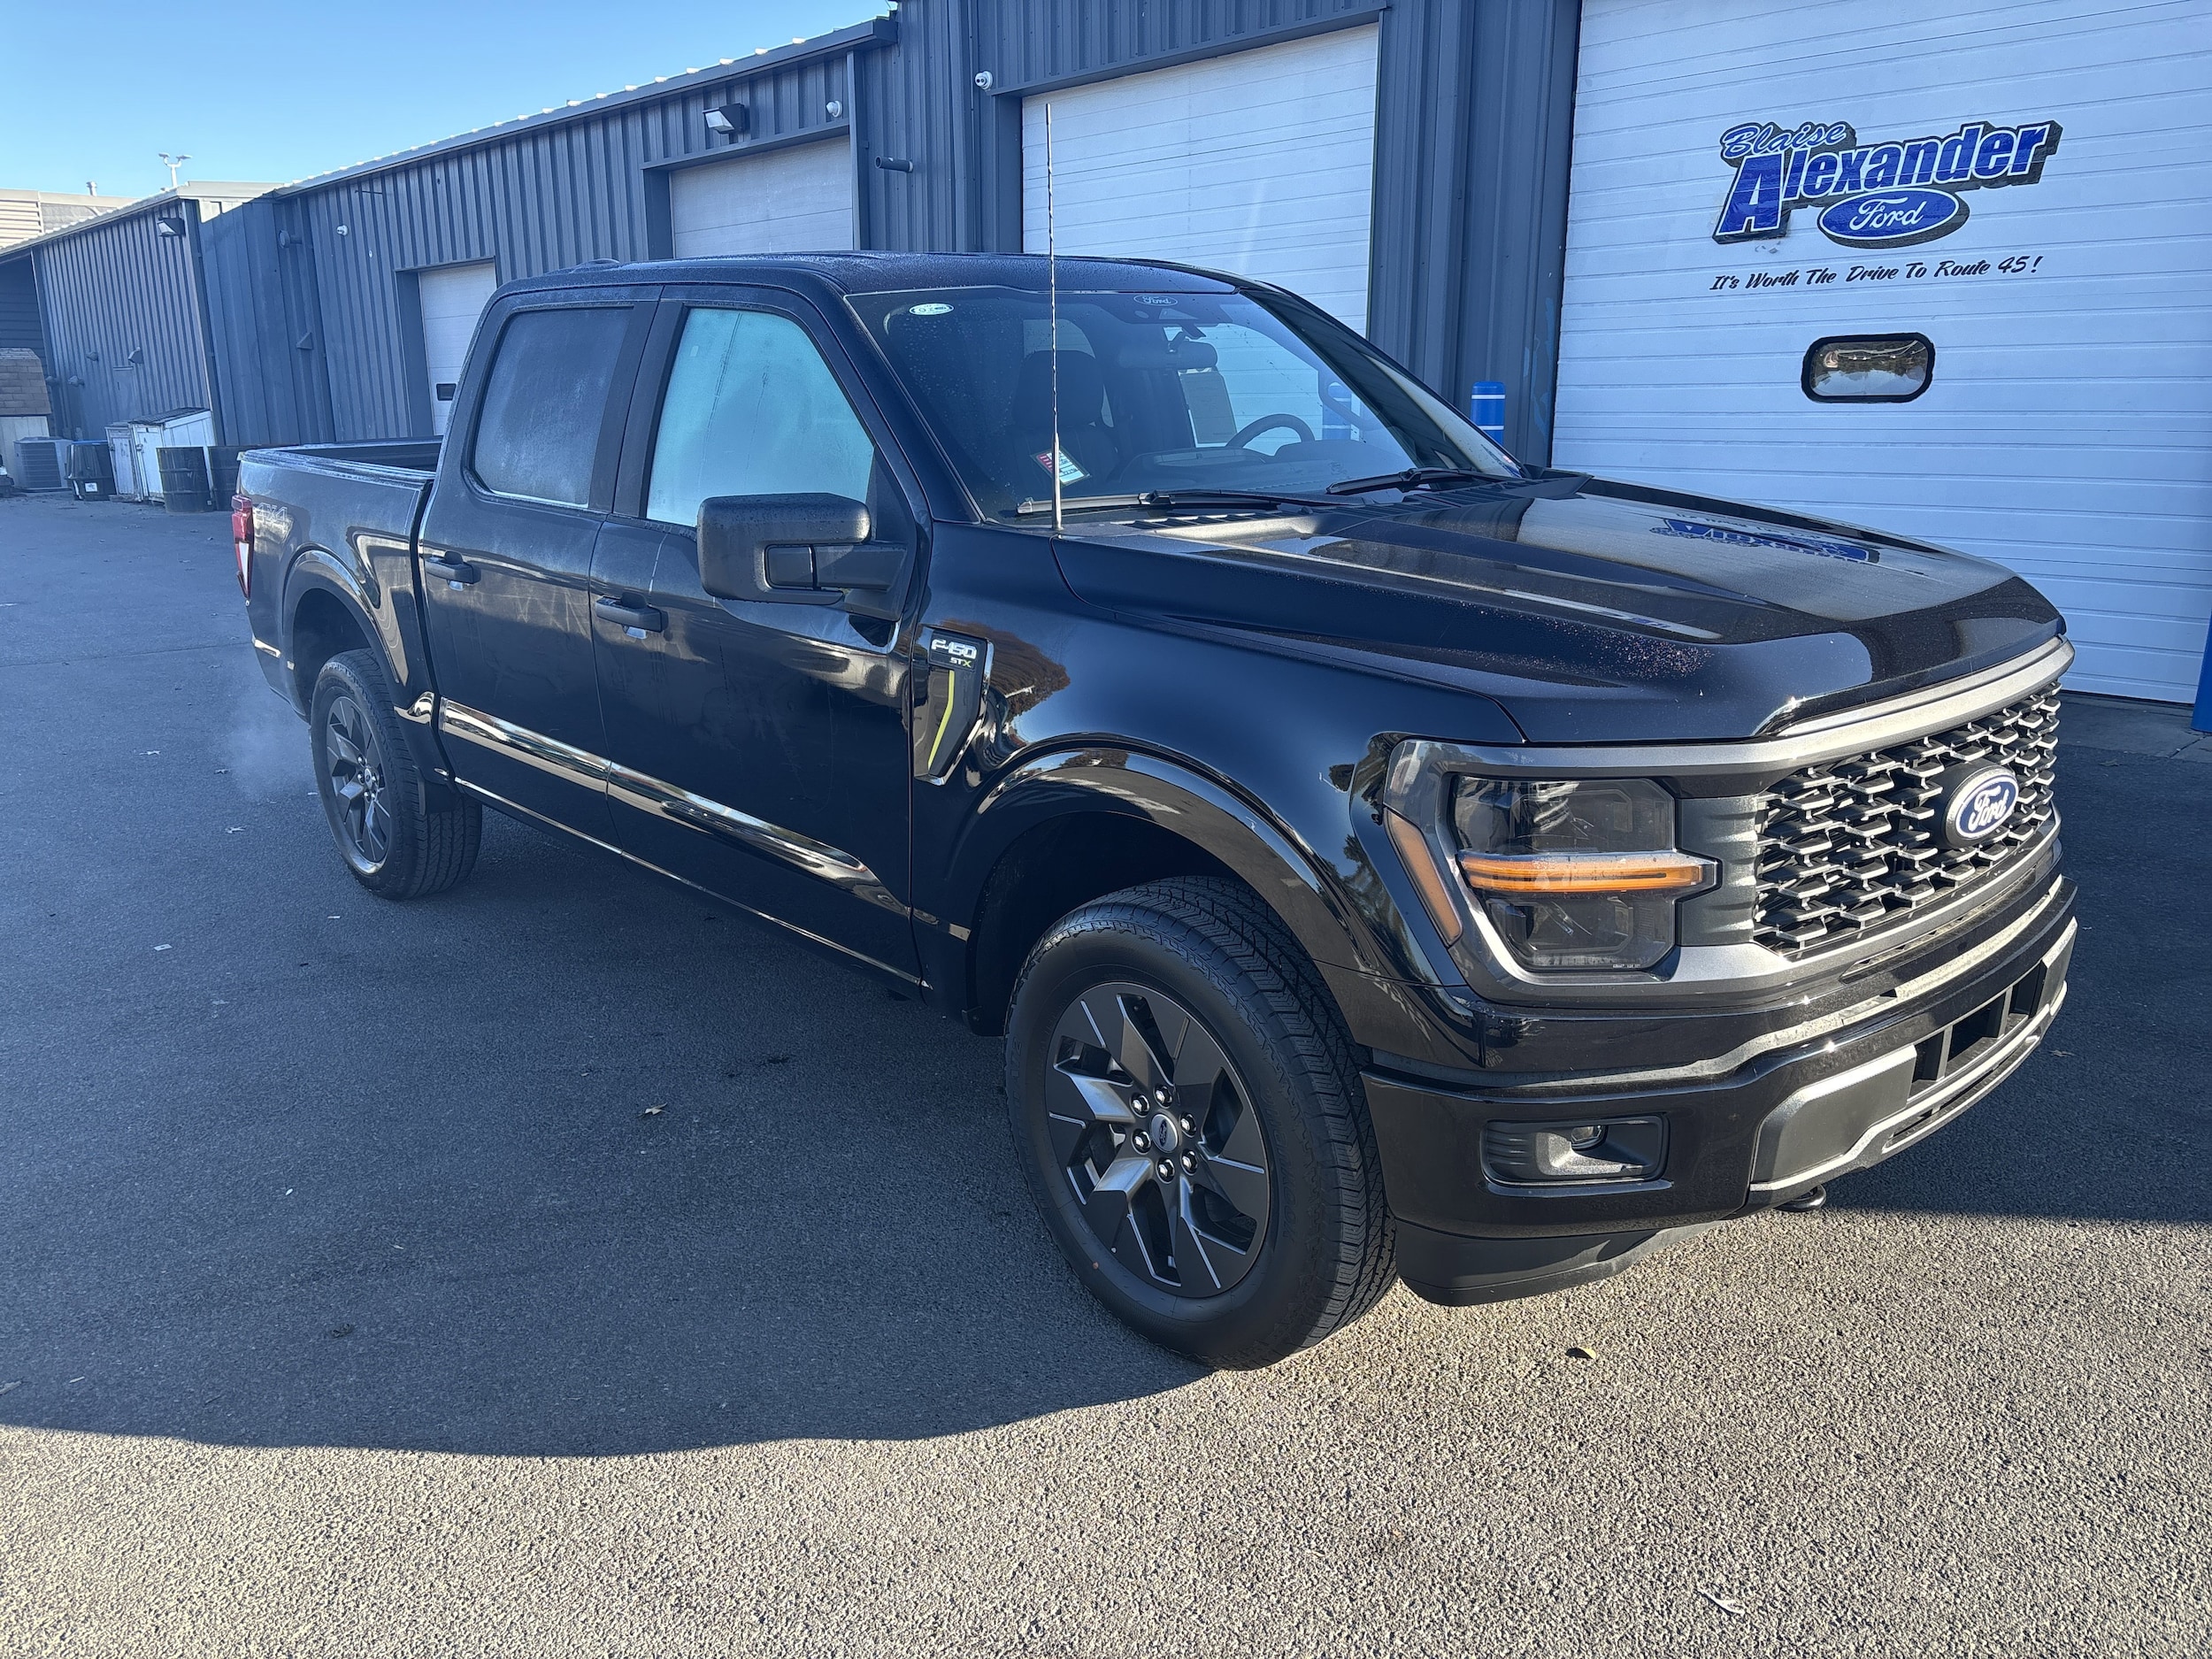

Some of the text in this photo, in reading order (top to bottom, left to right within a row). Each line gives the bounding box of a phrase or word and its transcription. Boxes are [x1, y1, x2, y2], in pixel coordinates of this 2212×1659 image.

[1721, 121, 1850, 161] Blaise
[1714, 121, 2058, 239] Alexander
[1849, 197, 1925, 230] Ford
[1709, 273, 1740, 290] It's
[1746, 271, 1799, 289] Worth
[1806, 267, 1837, 285] The
[1847, 263, 1898, 282] Drive
[1906, 261, 1927, 279] To
[1934, 259, 1991, 277] Route
[949, 657, 972, 667] STX
[1968, 785, 2009, 832] Ford
